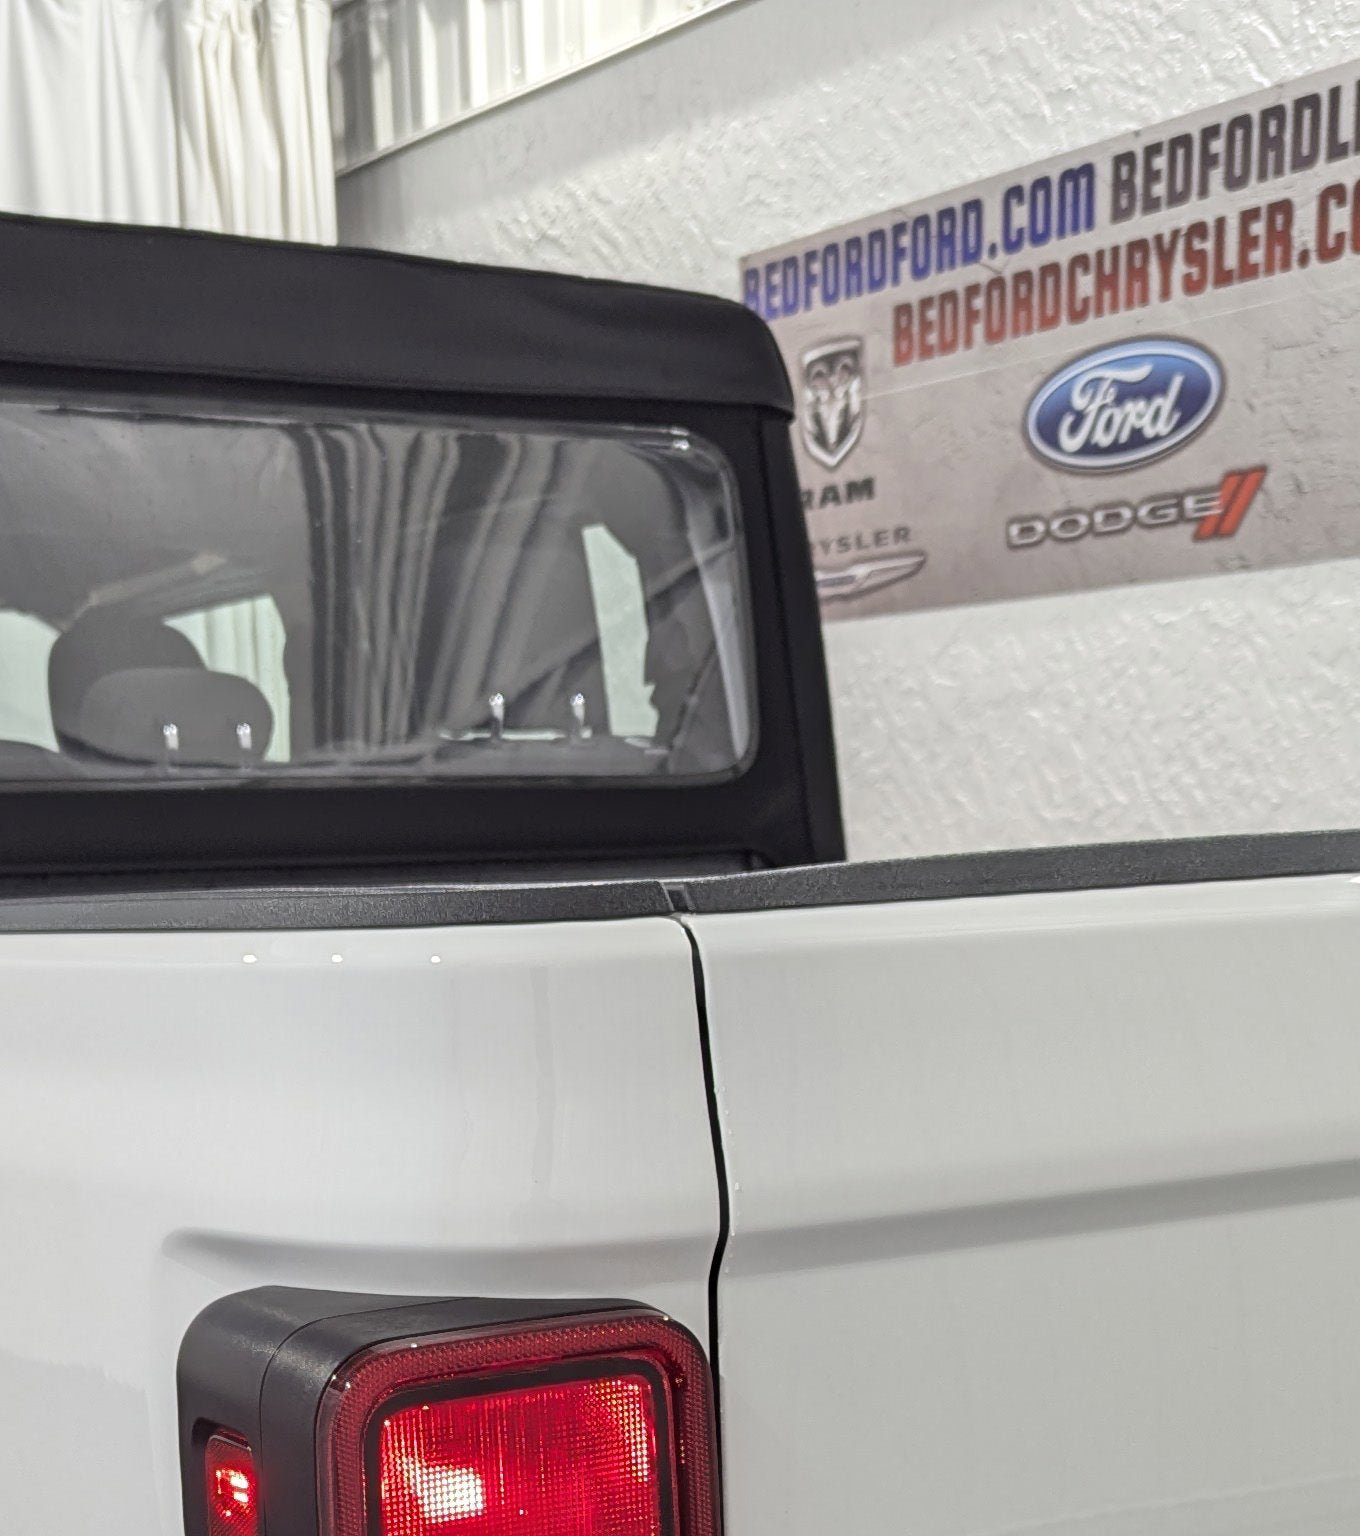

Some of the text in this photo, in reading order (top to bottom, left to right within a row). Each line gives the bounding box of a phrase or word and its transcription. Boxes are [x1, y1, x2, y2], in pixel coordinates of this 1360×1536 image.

[743, 162, 1096, 322] BEDFORDFORD.COM
[1058, 363, 1186, 453] Ford
[1006, 486, 1224, 549] DODGE
